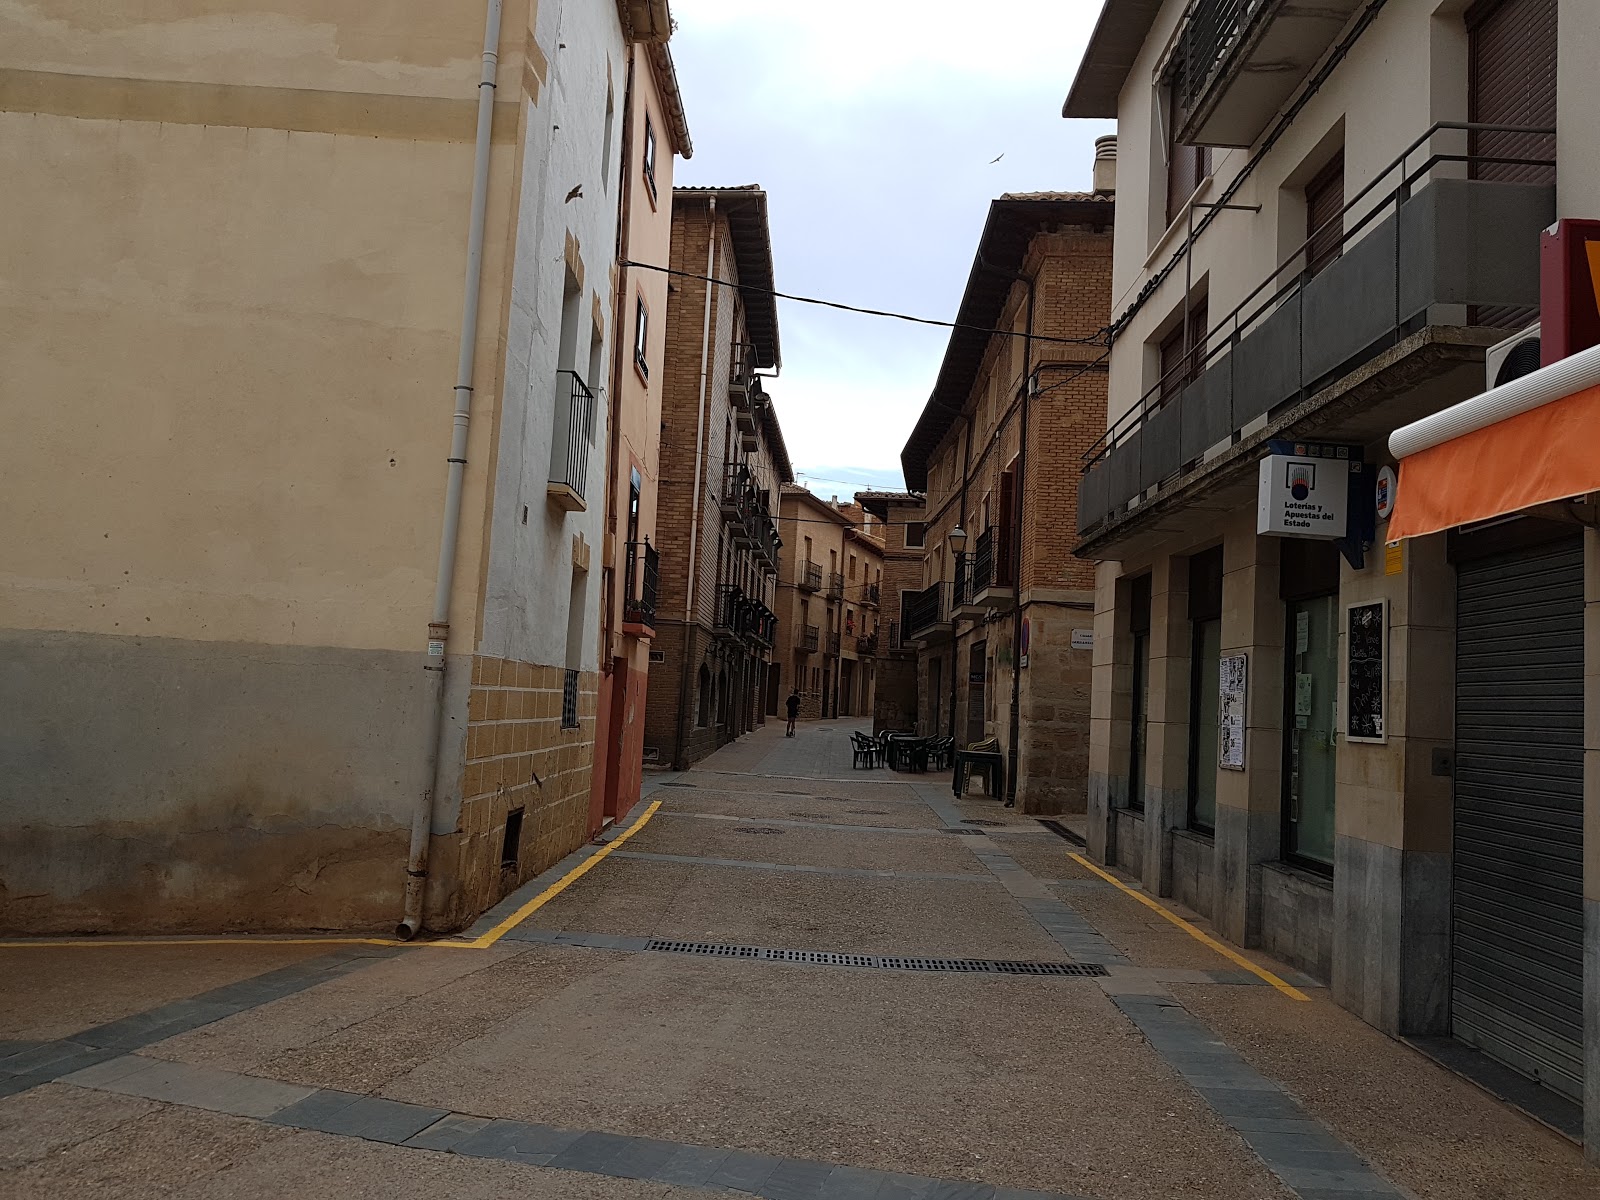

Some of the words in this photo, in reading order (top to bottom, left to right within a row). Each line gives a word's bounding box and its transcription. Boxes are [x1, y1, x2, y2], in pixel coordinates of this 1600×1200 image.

[1317, 504, 1323, 513] y
[1284, 510, 1320, 520] Apuestas
[1322, 512, 1334, 521] del
[1283, 519, 1311, 528] Estado
